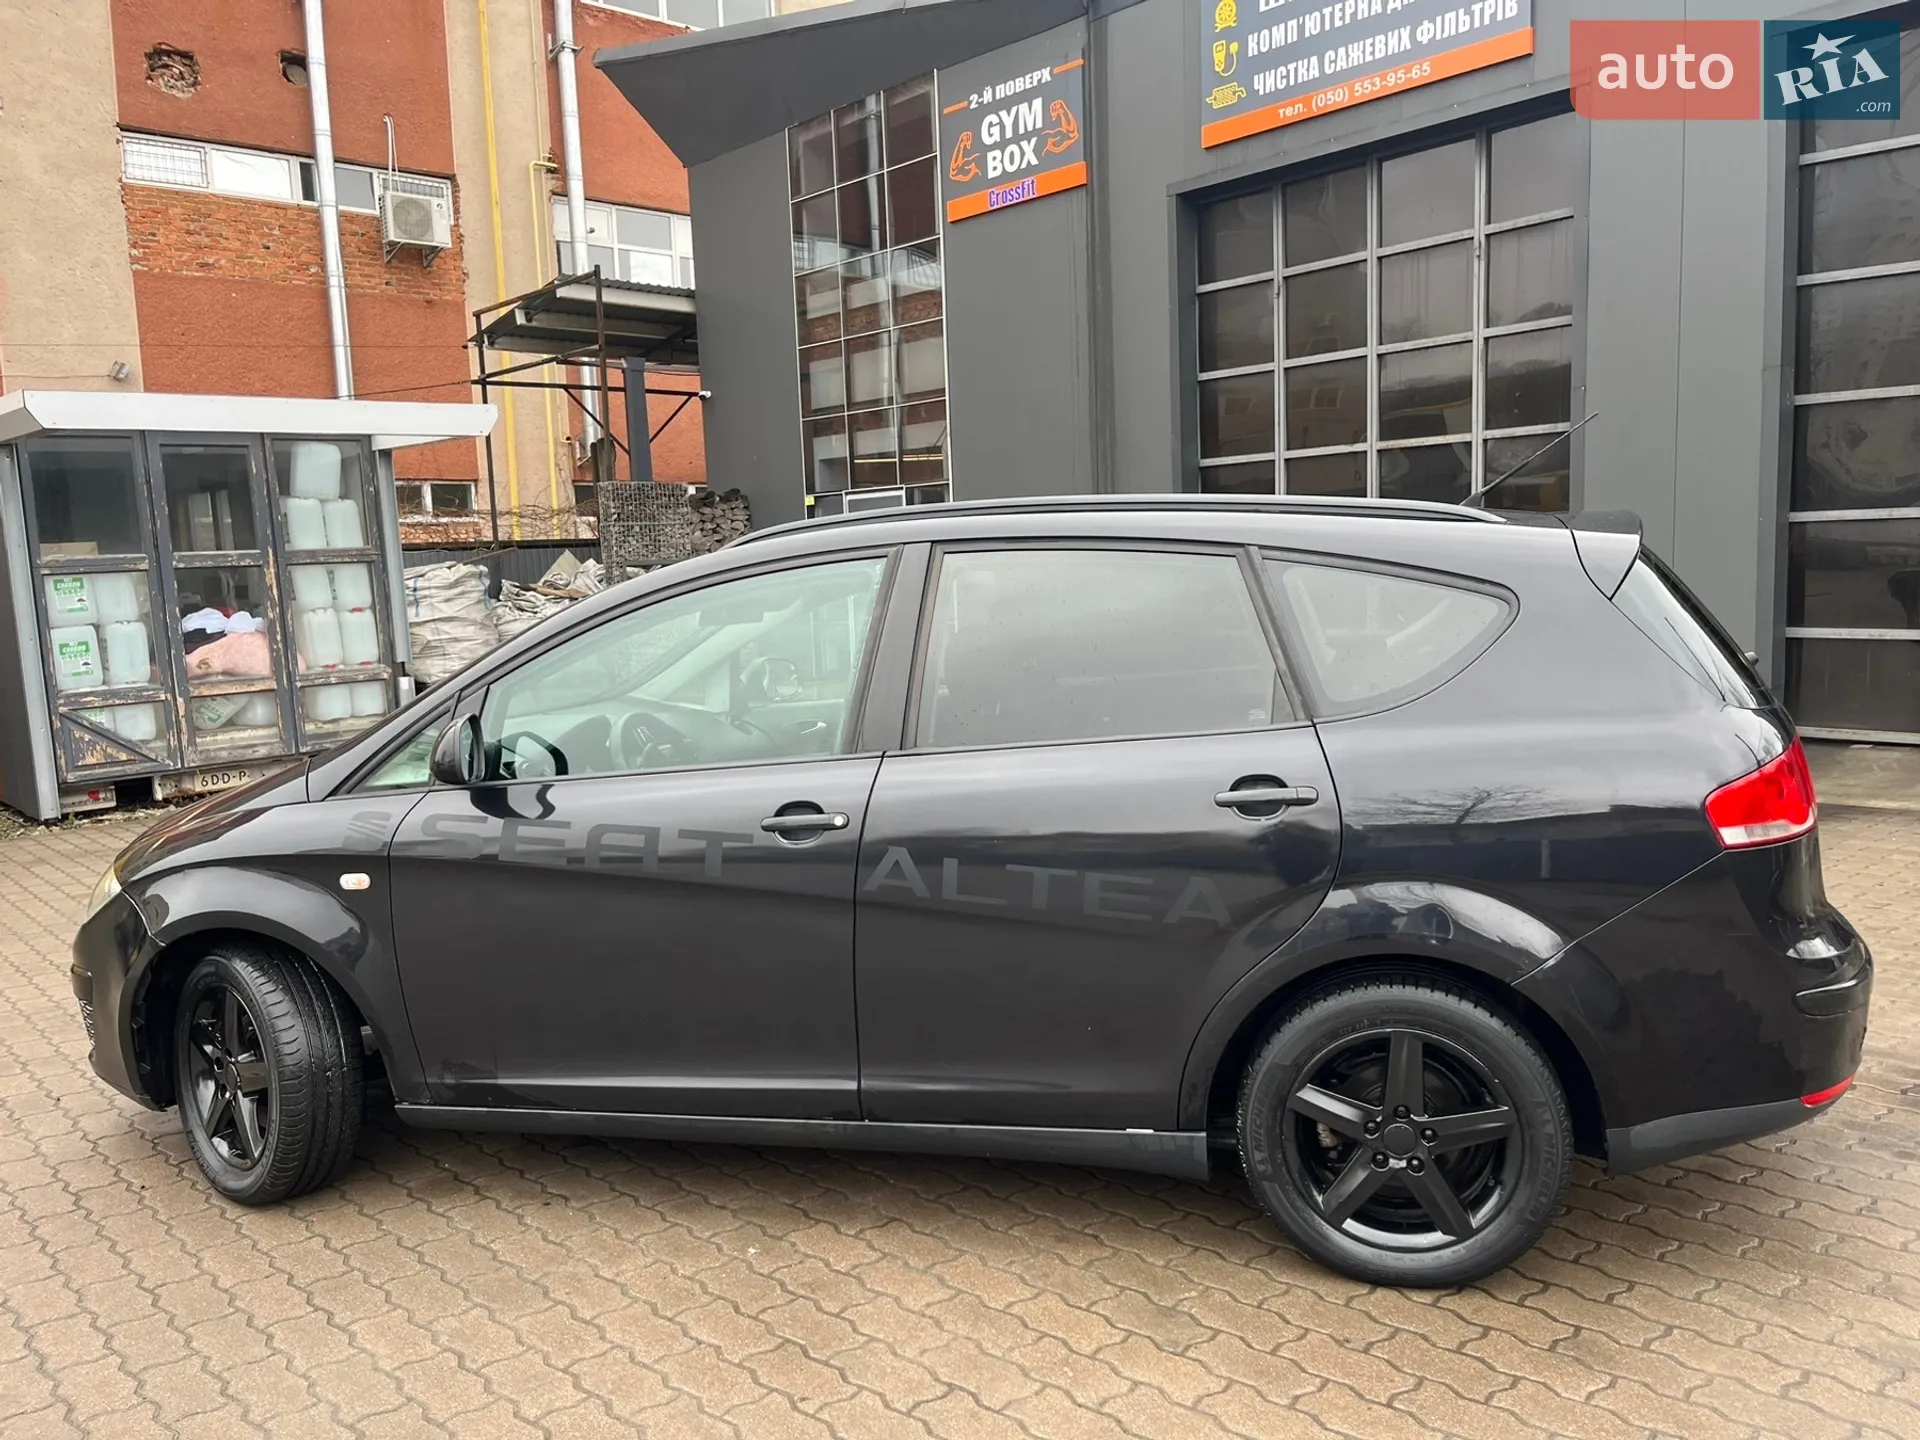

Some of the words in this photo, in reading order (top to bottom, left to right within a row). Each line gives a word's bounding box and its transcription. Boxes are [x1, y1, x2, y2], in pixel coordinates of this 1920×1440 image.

[1253, 55, 1319, 96] ЧИСТКА
[1323, 25, 1412, 75] САЖЕВИХ
[1416, 0, 1519, 44] ФІЛЬТРІВ
[969, 86, 993, 109] 2-Й
[995, 66, 1052, 101] ПОВЕРХ
[1277, 103, 1308, 119] тел.
[1311, 86, 1350, 113] (050)
[1353, 61, 1432, 97] 553-95-65
[980, 96, 1043, 146] GYM
[986, 136, 1040, 180] BOX
[988, 178, 1037, 208] CrossFit
[420, 812, 755, 879] SEAT
[861, 845, 1237, 931] ALTEA
